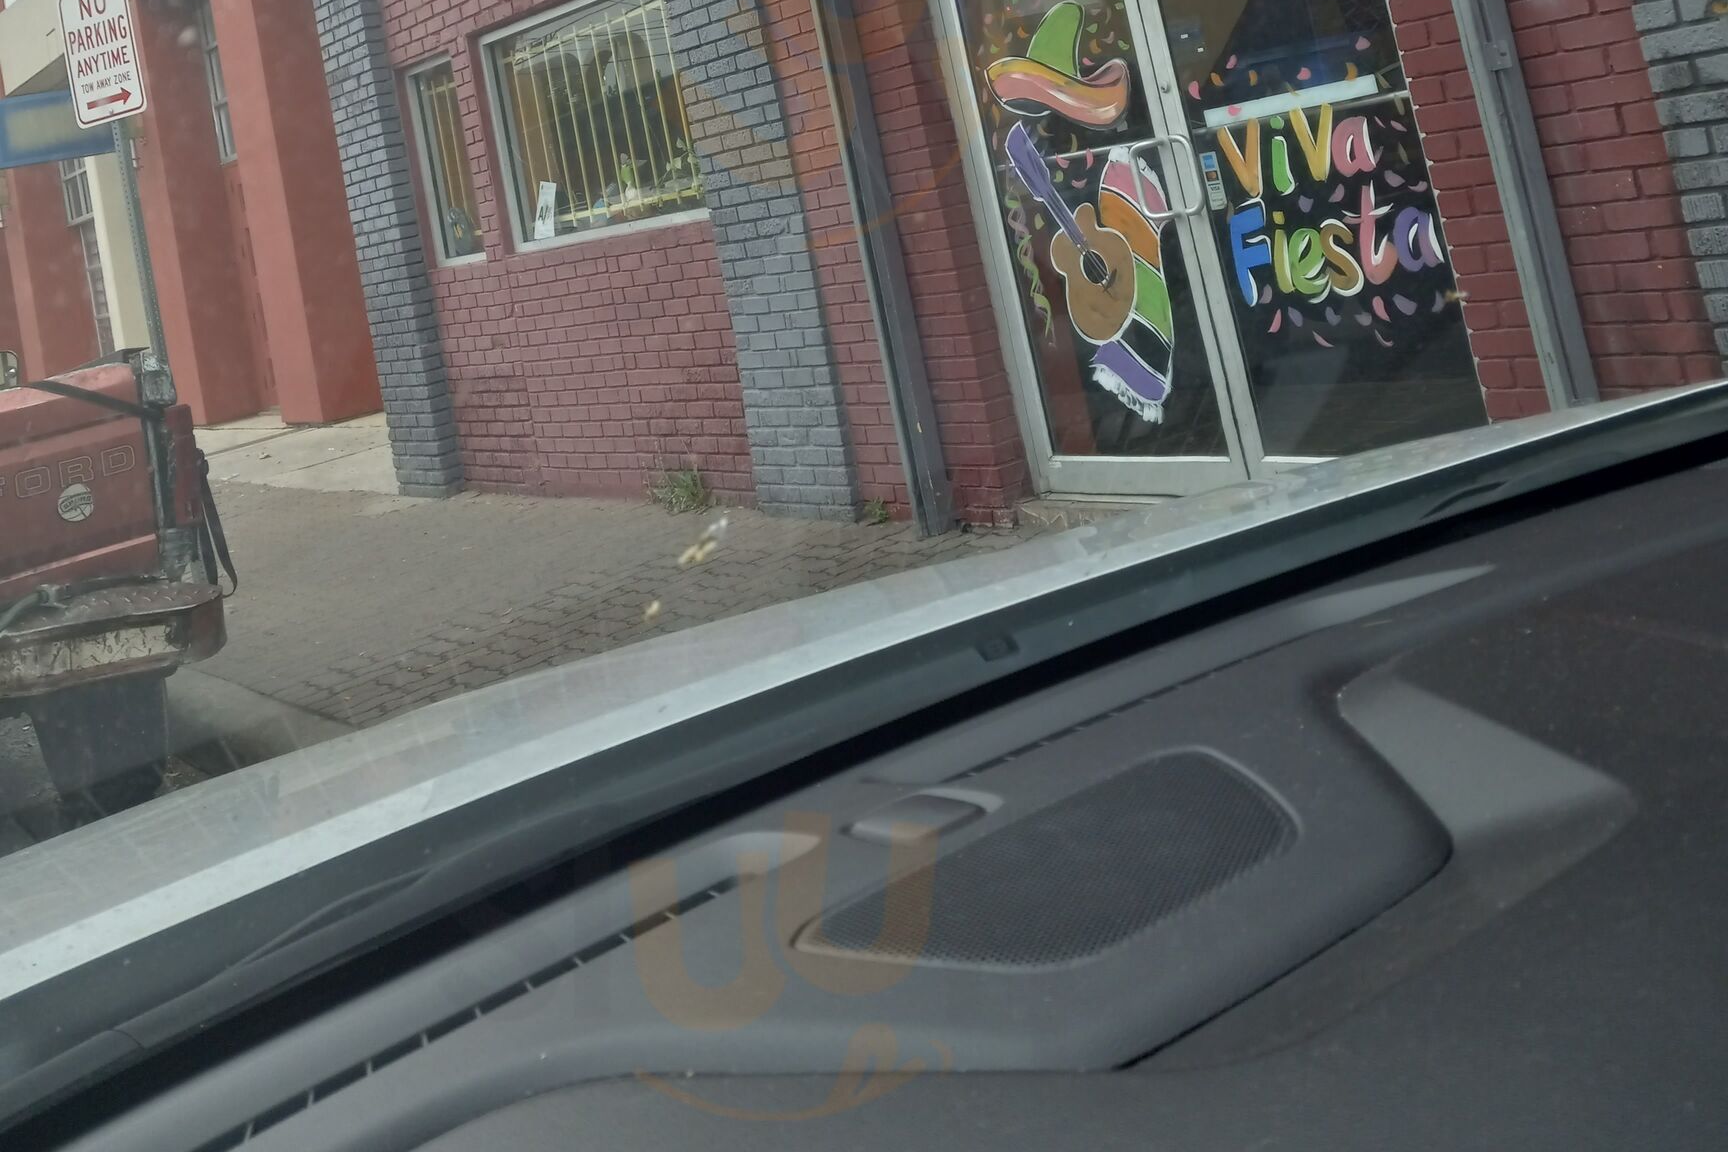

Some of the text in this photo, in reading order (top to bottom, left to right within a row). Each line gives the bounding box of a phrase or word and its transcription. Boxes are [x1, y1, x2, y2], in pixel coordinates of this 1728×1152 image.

[68, 14, 127, 55] PARKING
[77, 45, 130, 79] ANYTIME
[81, 71, 132, 94] TOW AWAY ZONE
[1230, 180, 1445, 307] Fiesta
